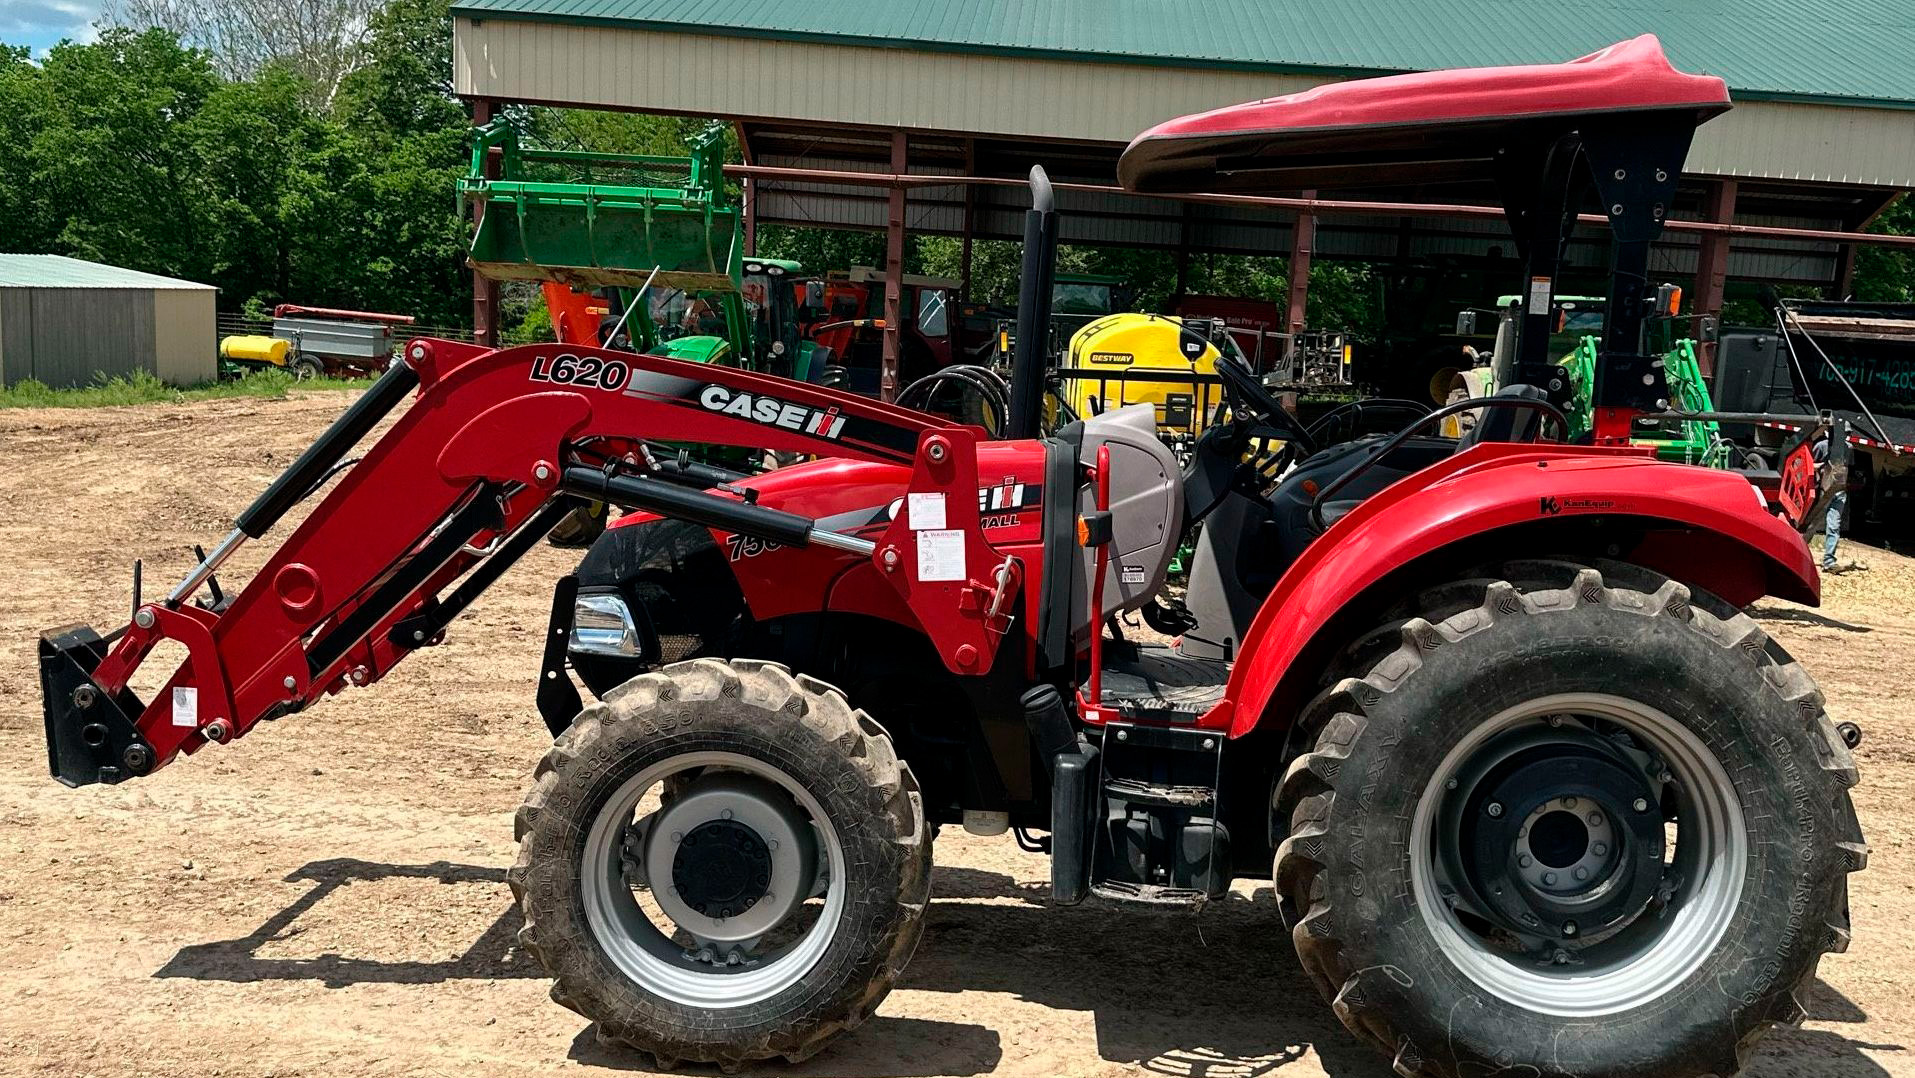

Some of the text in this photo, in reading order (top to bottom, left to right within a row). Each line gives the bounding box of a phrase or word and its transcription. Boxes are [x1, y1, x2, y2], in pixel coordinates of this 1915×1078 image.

[529, 354, 629, 391] L620
[1091, 353, 1133, 364] BESTWAY
[700, 385, 806, 429] CASE
[642, 709, 695, 737] 850
[1350, 727, 1401, 898] GALAXY
[1775, 880, 1812, 958] Radial
[1742, 961, 1781, 1007] 850
